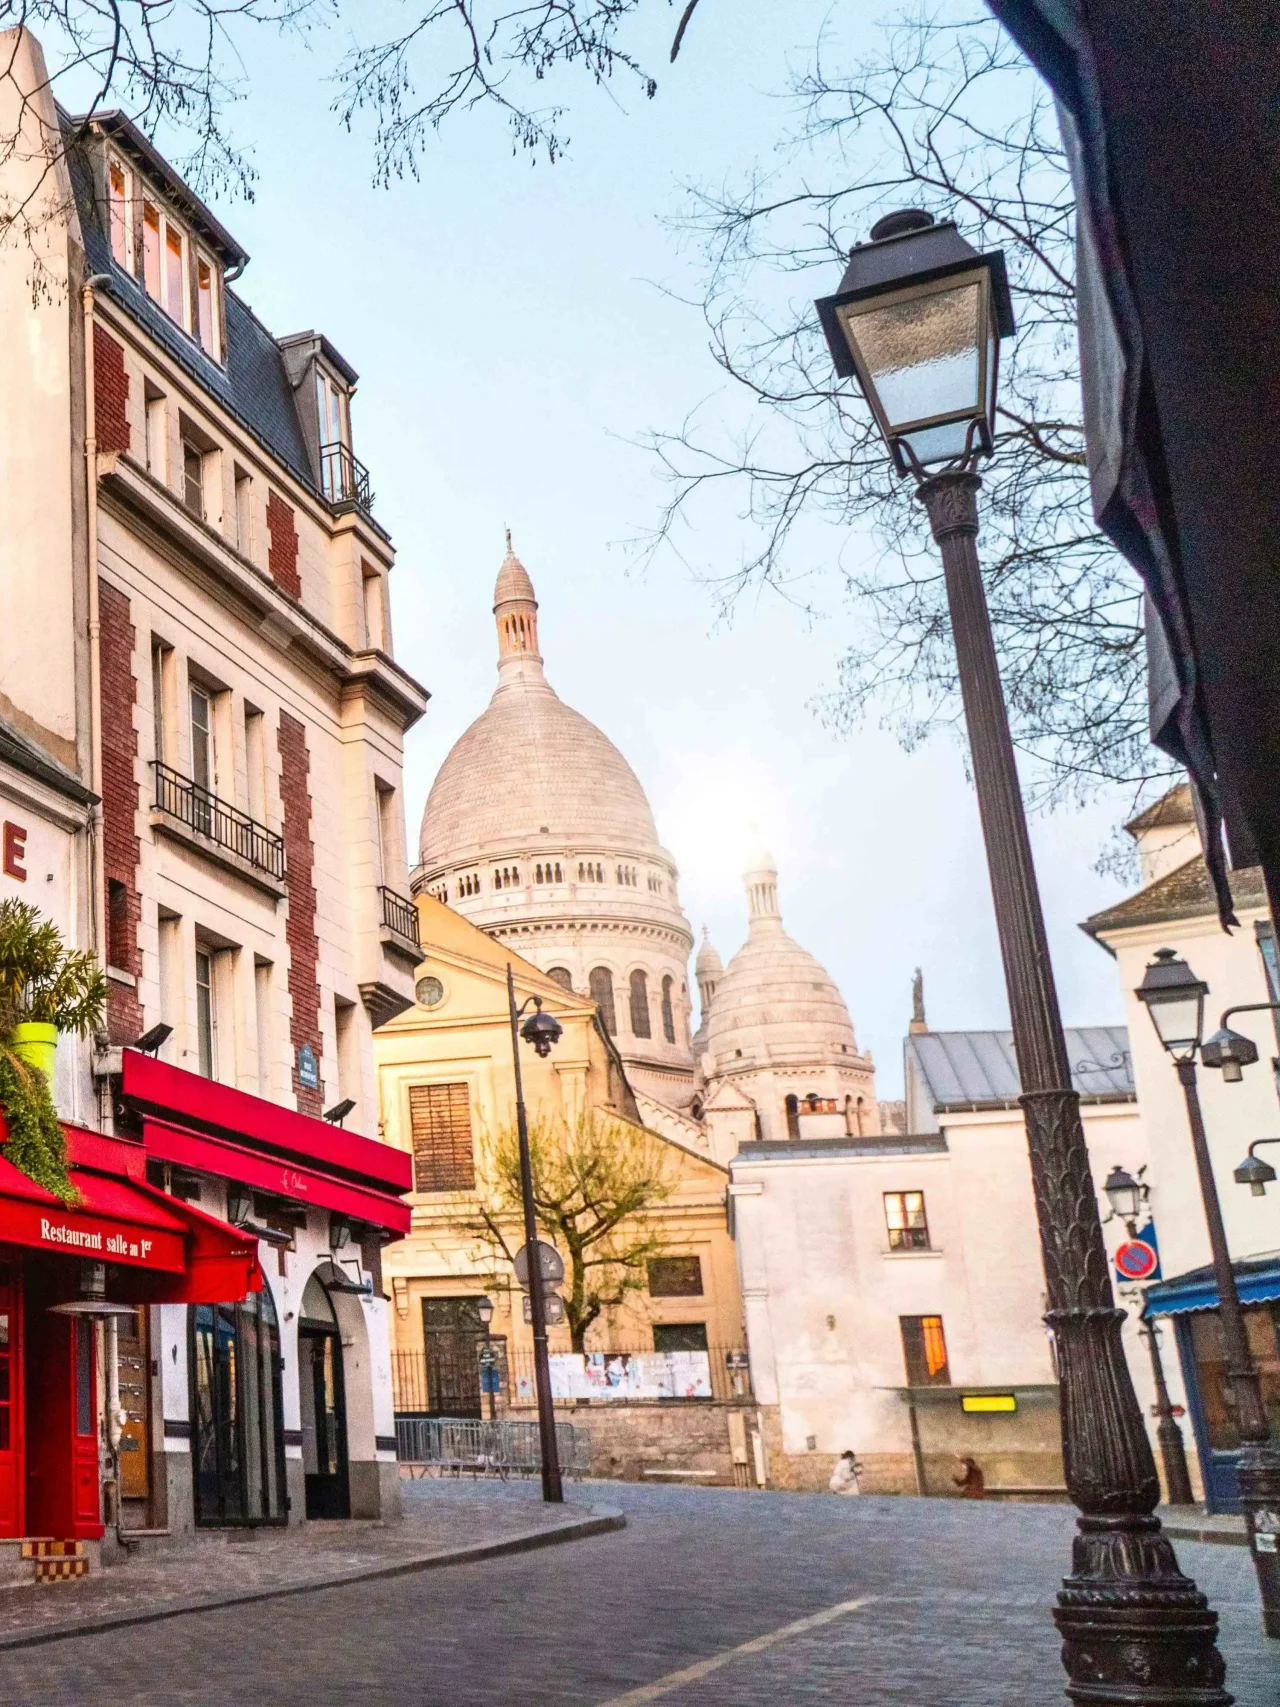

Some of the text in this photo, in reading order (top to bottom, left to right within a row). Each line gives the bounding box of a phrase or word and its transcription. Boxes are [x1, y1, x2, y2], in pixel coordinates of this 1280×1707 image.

[40, 1218, 153, 1258] Restaurant salle au 1er
